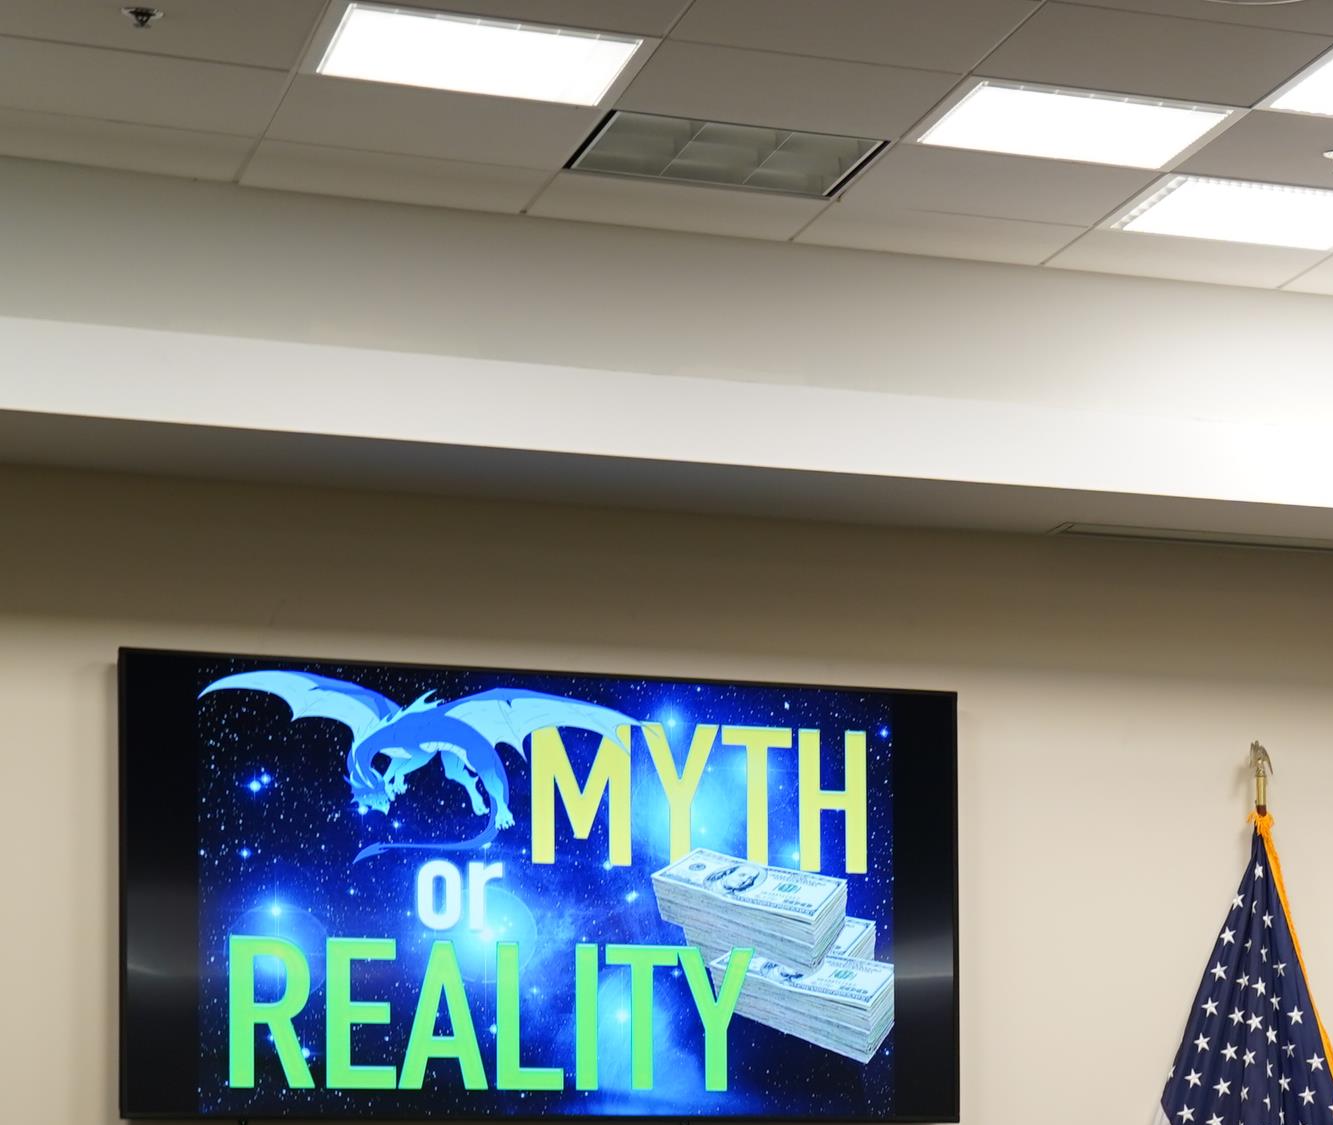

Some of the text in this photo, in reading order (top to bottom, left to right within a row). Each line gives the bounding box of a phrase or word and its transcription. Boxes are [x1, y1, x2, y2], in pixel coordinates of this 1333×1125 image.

[530, 723, 867, 875] MYTH
[417, 858, 505, 932] or
[228, 935, 755, 1092] REALITY
